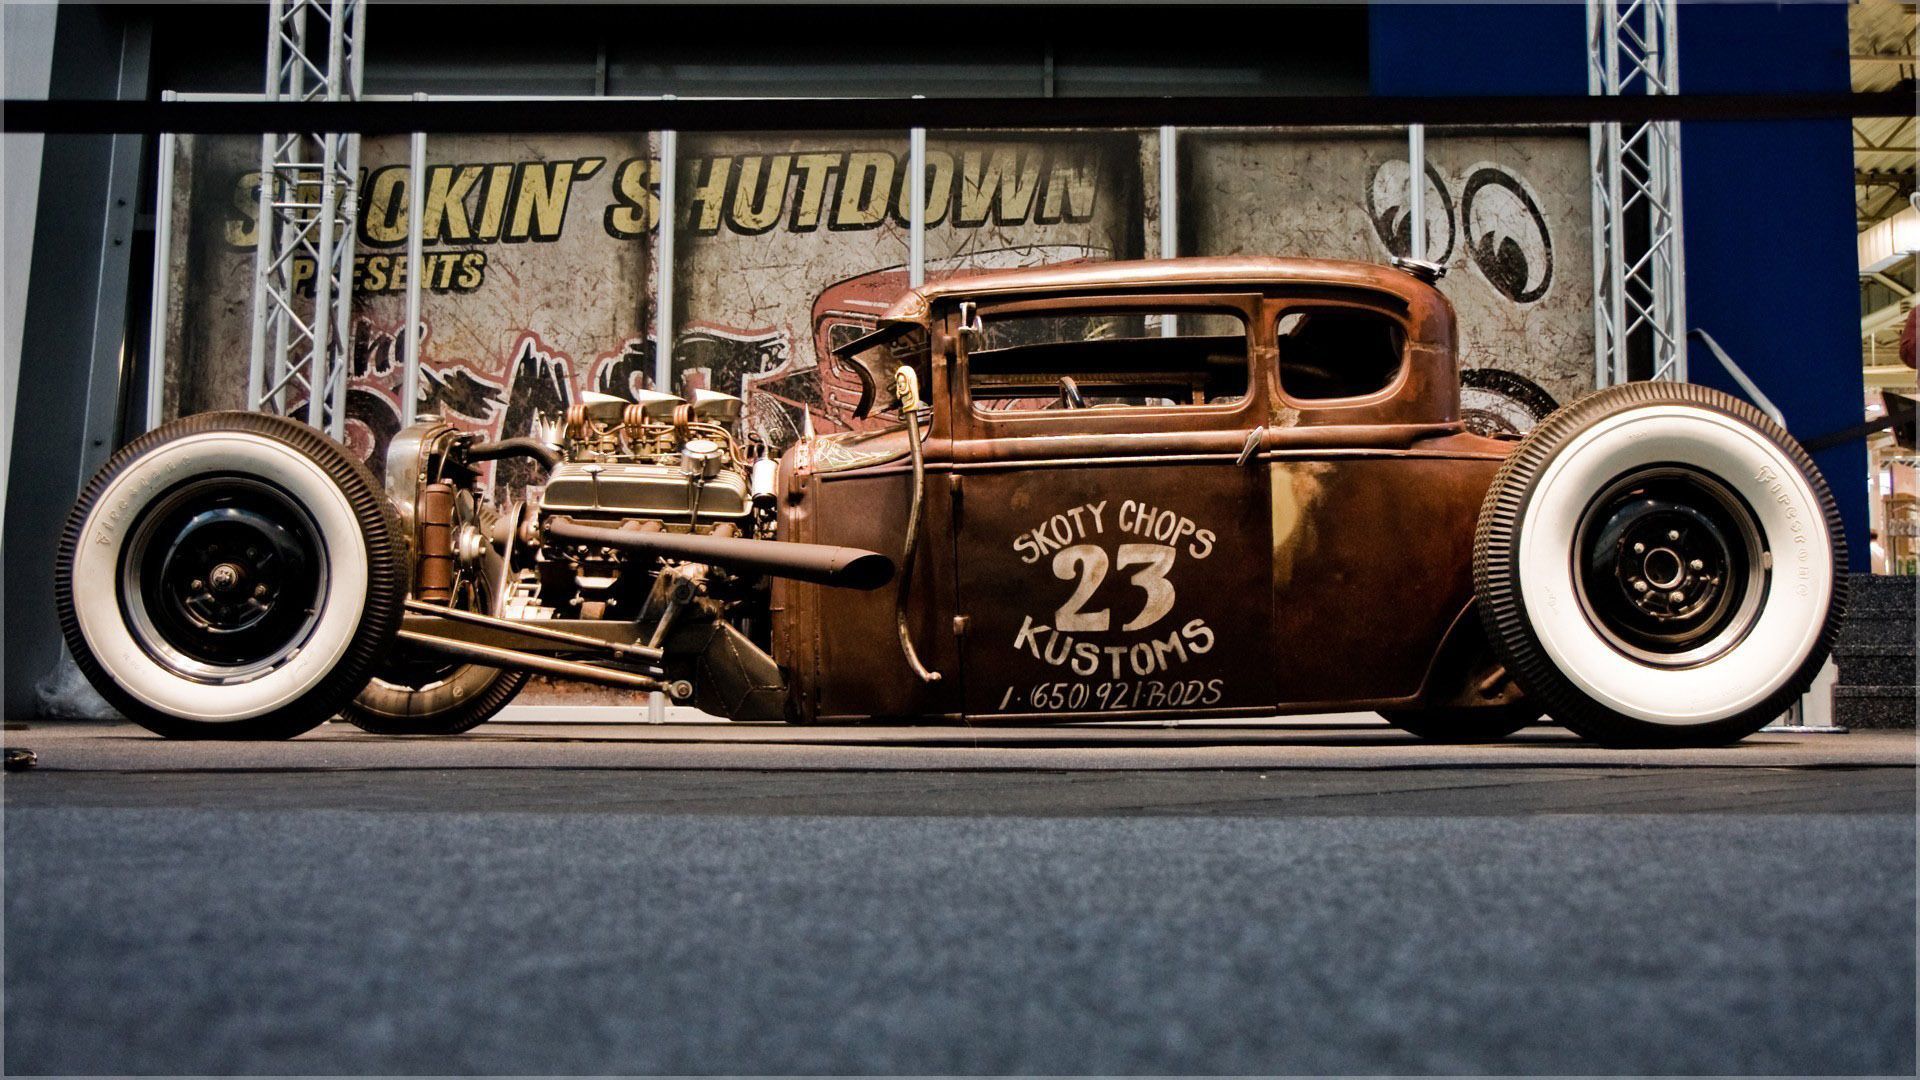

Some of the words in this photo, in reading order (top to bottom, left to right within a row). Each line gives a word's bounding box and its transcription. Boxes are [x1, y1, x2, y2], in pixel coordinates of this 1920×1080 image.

[604, 150, 1099, 240] SHUTDOWN
[1013, 500, 1107, 564] SKOTY
[1118, 499, 1216, 560] CHOPS
[1052, 543, 1176, 632] 23
[1013, 615, 1215, 680] KUSTOMS
